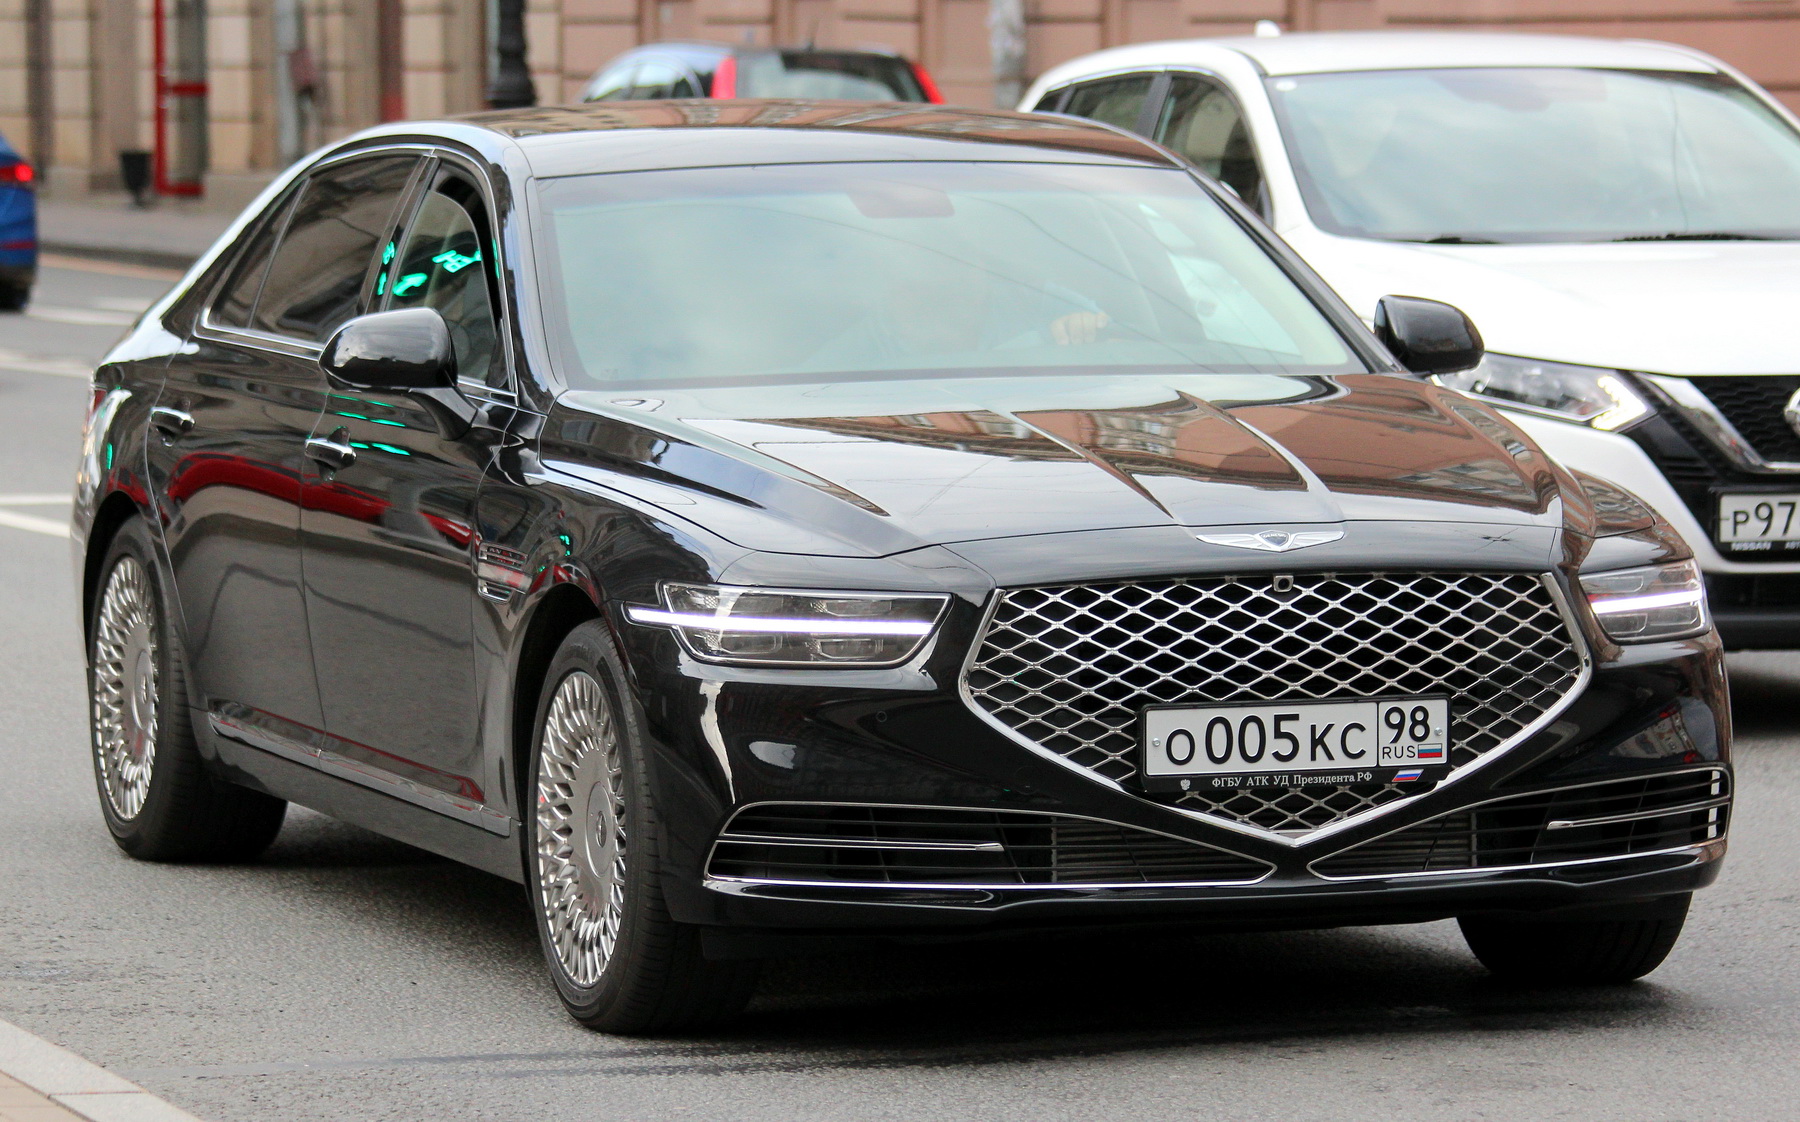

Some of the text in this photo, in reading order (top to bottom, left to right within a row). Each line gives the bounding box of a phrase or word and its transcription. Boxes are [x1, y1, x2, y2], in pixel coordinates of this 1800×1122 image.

[1384, 705, 1431, 744] 98
[1382, 745, 1416, 760] RUS
[1211, 771, 1373, 788] ФГБУ АТК УД Президента РФ
